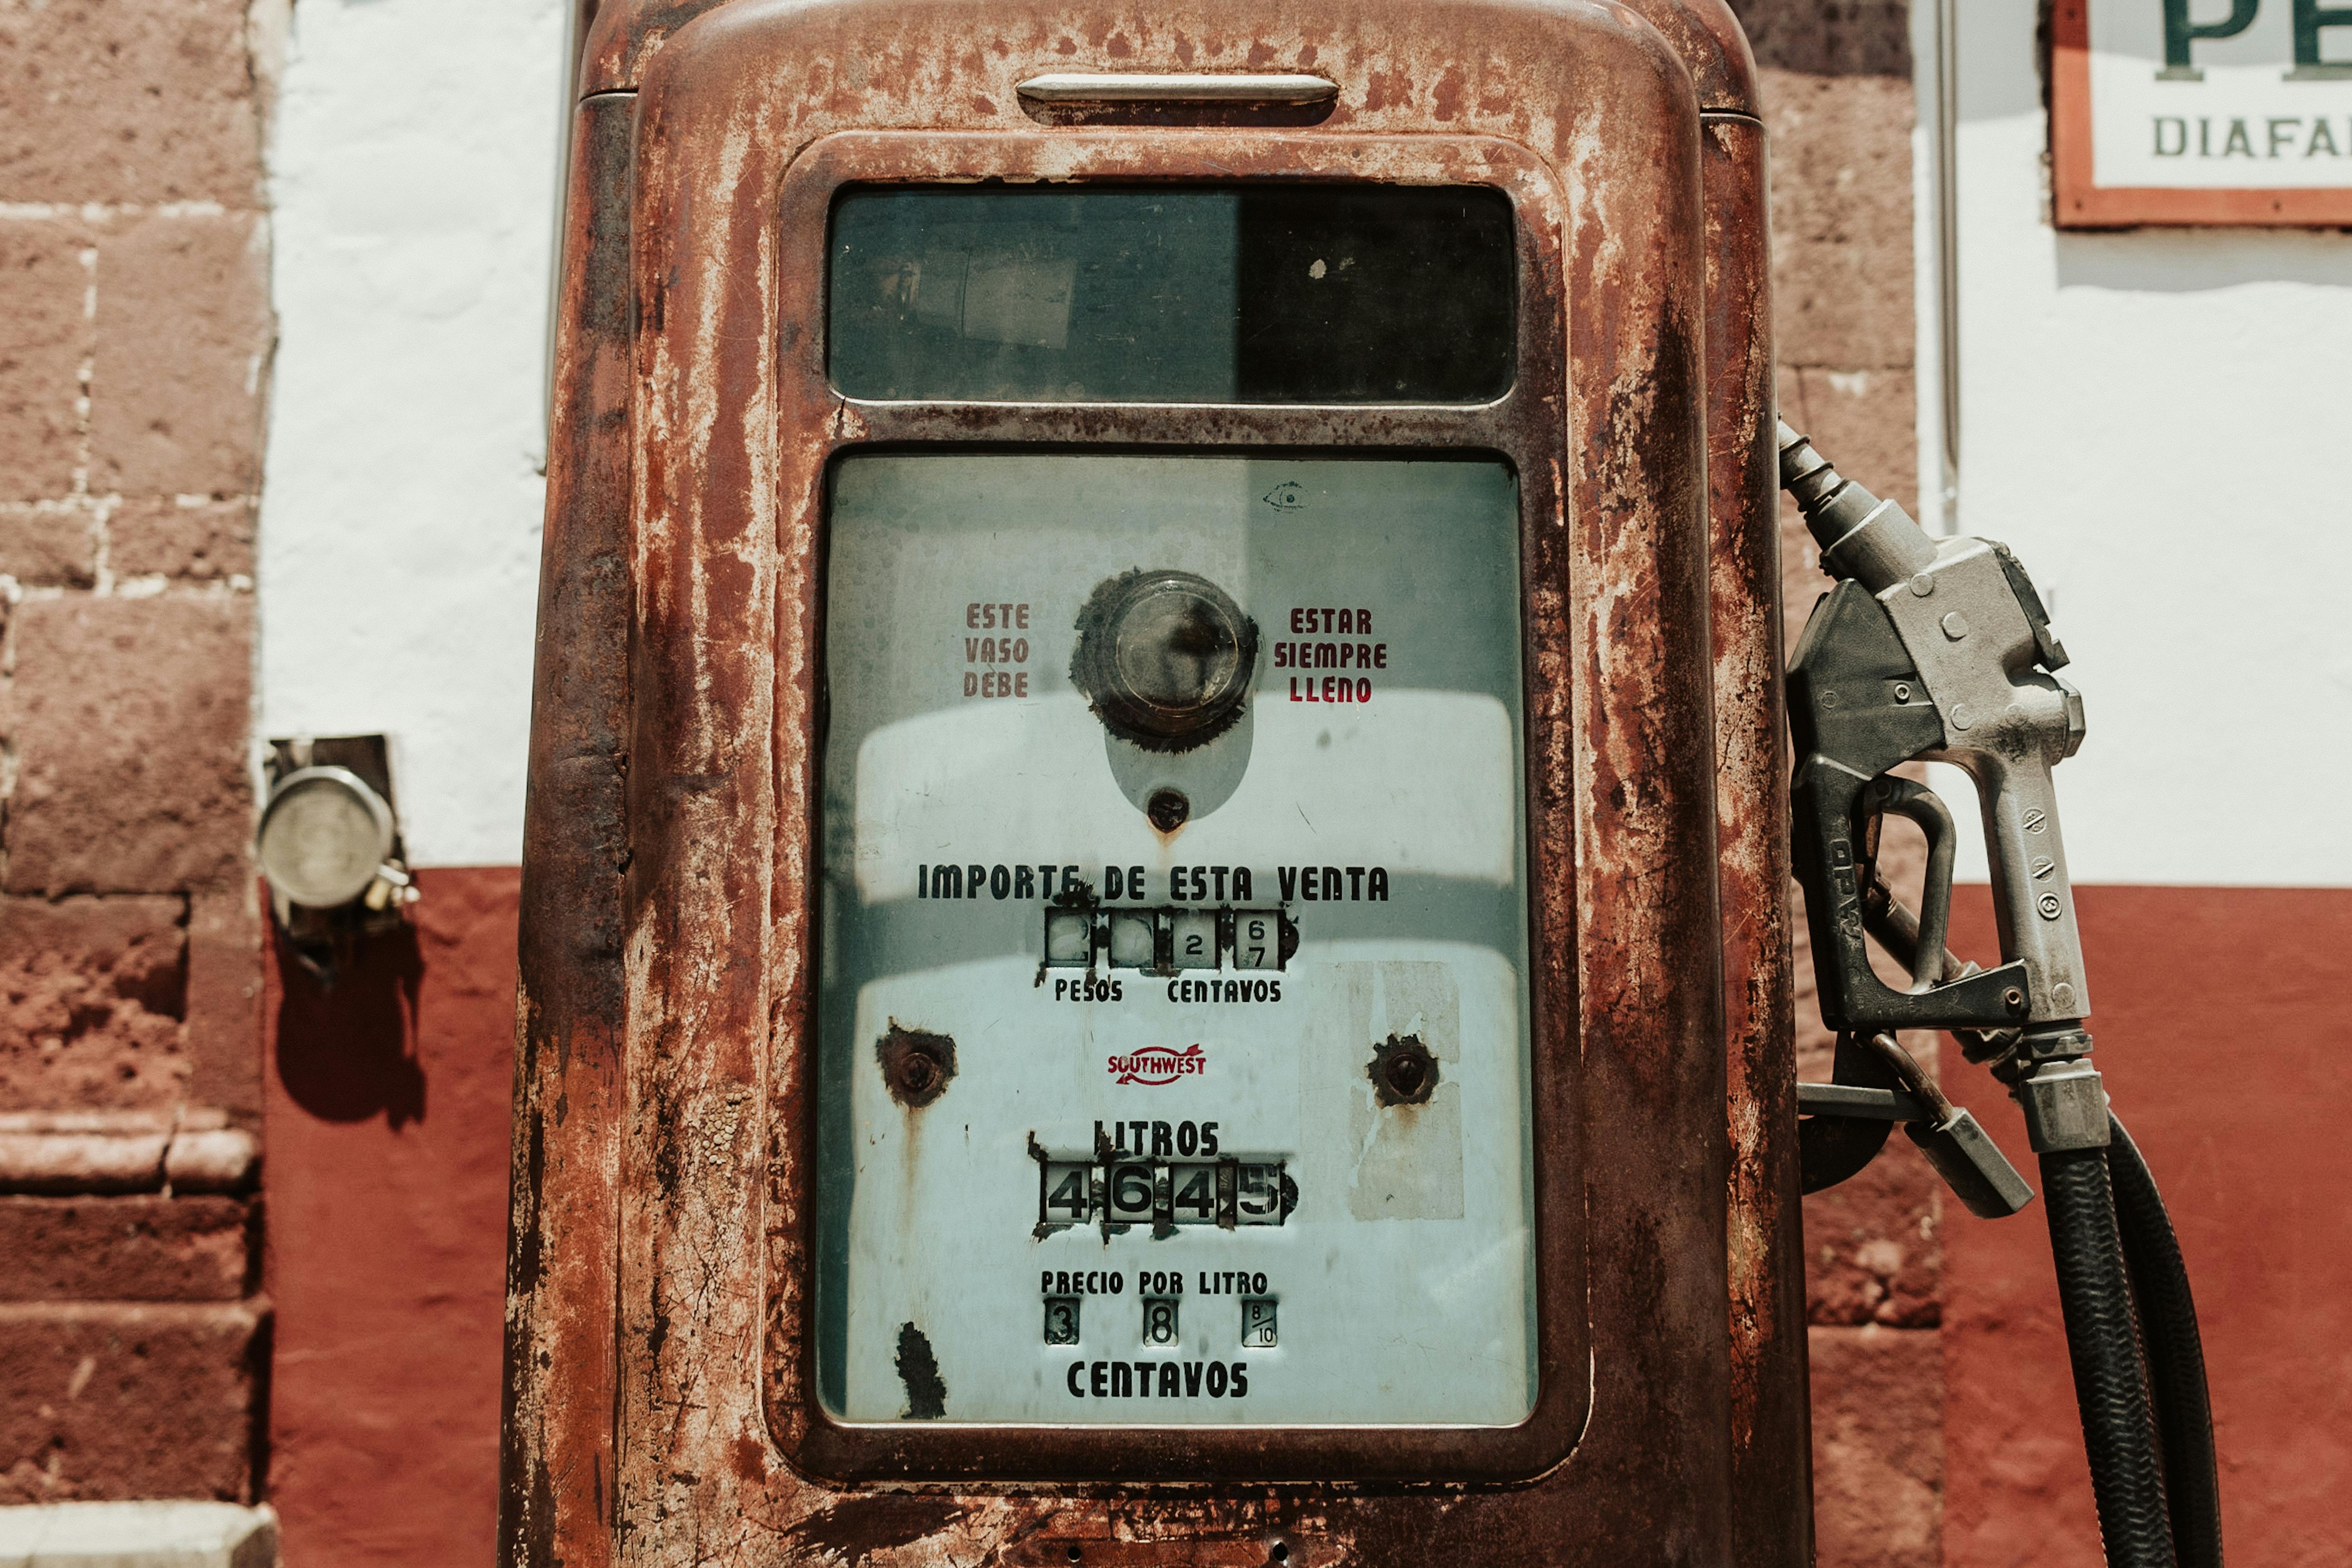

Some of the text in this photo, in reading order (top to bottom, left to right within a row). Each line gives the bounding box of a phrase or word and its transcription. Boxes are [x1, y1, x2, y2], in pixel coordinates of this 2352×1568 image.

[2152, 117, 2352, 157] DIAFA
[966, 603, 1029, 629] ESTE
[1290, 608, 1372, 634] ESTAR
[965, 637, 1029, 663] VASO
[1274, 642, 1387, 669] SIEMPRE
[964, 672, 1028, 698] DEBE
[1290, 676, 1371, 703] LLENO
[918, 864, 1388, 902] IMPORTE DE ESTA VENTA
[1186, 935, 1203, 955] 2
[1056, 979, 1122, 1002] PESOS
[1167, 980, 1281, 1003] CENTAVOS
[1108, 1056, 1206, 1074] SOUTHWEST
[1094, 1120, 1218, 1156] LITROS
[1042, 1271, 1267, 1294] PRECIO POR LITRO
[1053, 1306, 1073, 1342] 3
[1152, 1306, 1172, 1343] 8
[1067, 1361, 1248, 1398] CENTAVOS
